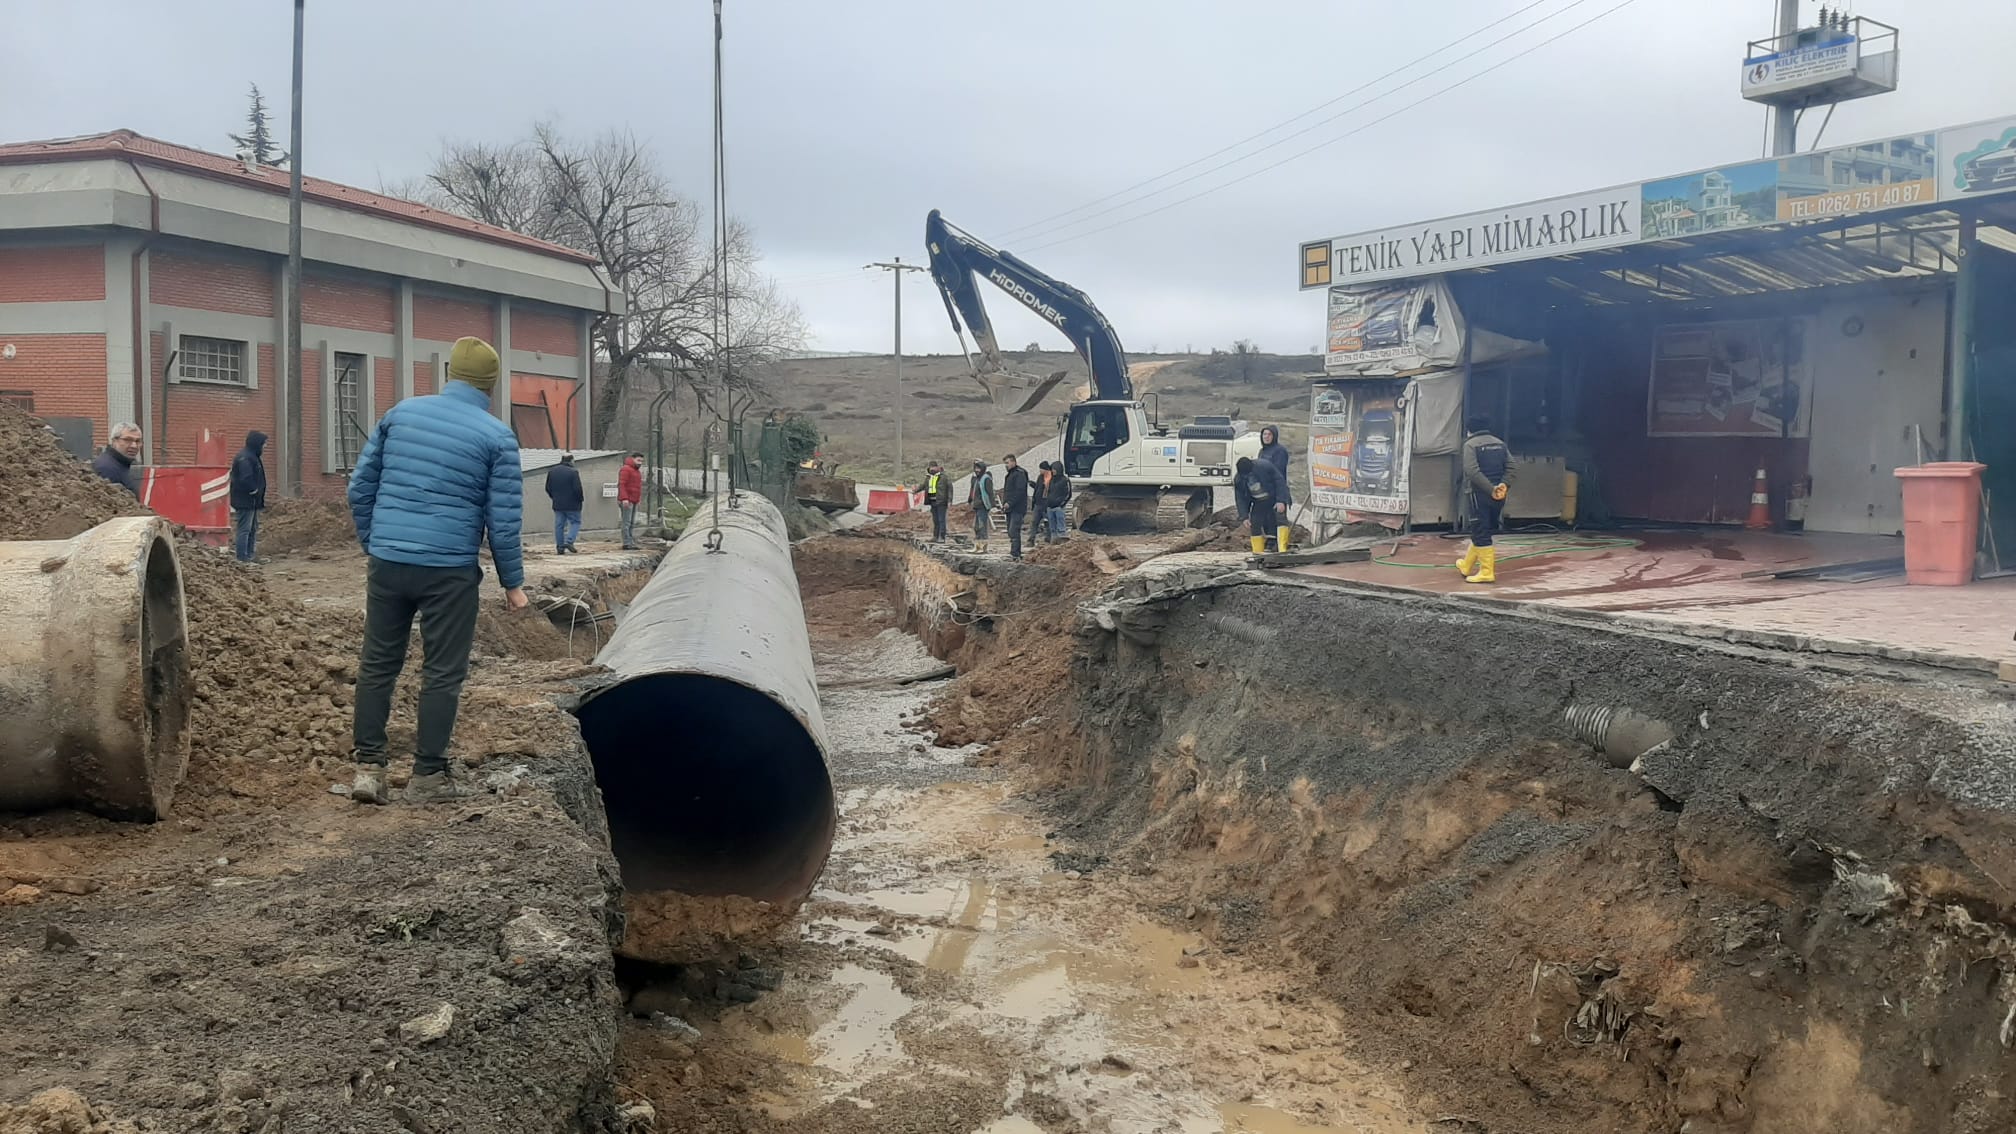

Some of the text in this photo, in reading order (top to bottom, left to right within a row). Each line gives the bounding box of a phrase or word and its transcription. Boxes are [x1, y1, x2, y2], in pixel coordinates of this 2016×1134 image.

[1790, 184, 1921, 217] TEL: 0262 751 40 87
[1335, 200, 1632, 276] TENİK YAPI MİMARLIK
[1200, 467, 1231, 477] 300
